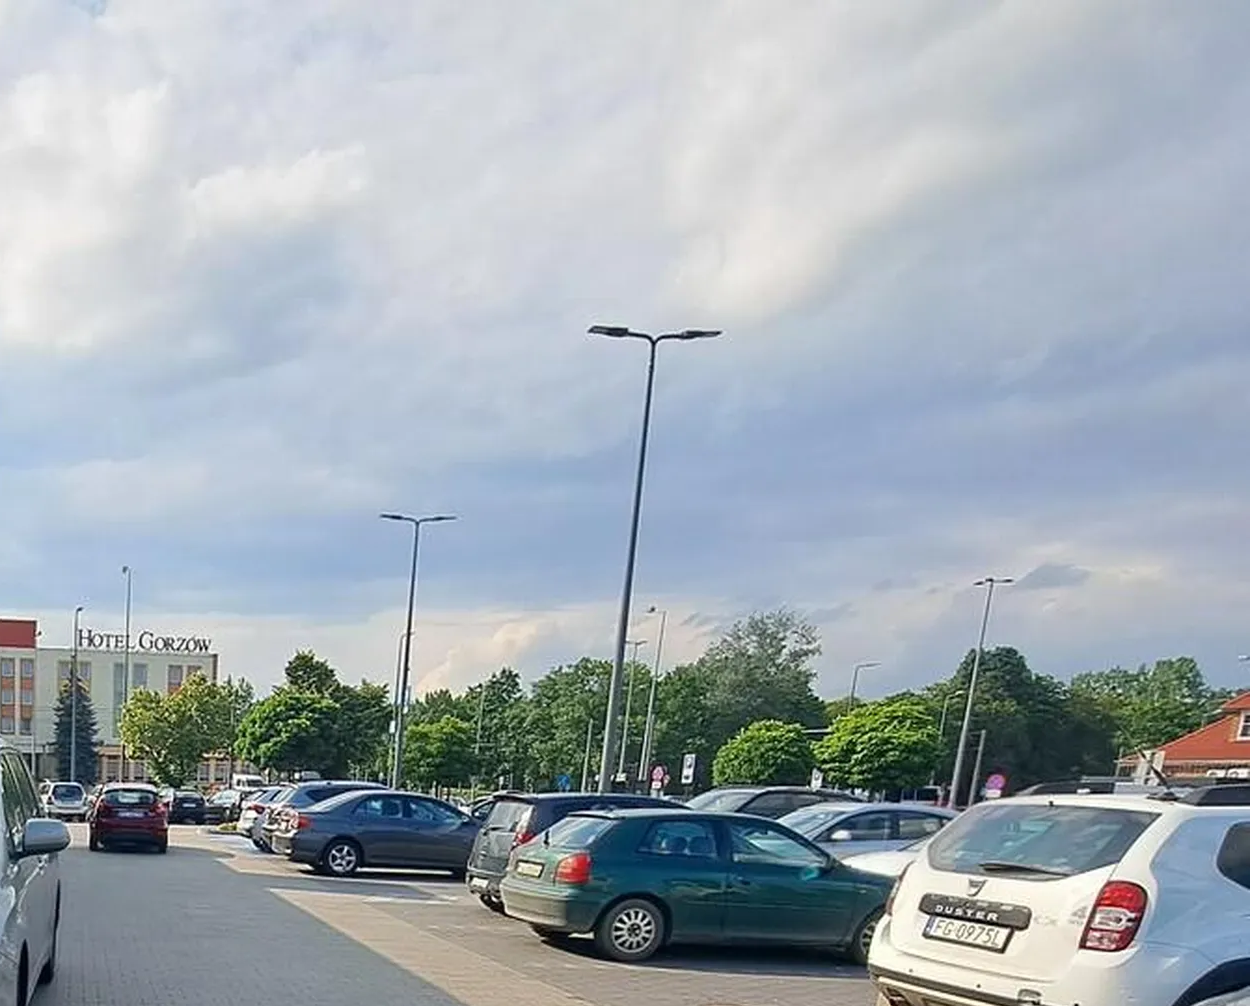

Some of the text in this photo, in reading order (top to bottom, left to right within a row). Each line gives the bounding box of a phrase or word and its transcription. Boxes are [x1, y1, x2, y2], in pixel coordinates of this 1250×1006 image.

[78, 629, 136, 650] HOTEL
[935, 904, 999, 922] DUSTER
[934, 919, 1000, 947] FG 0975L
